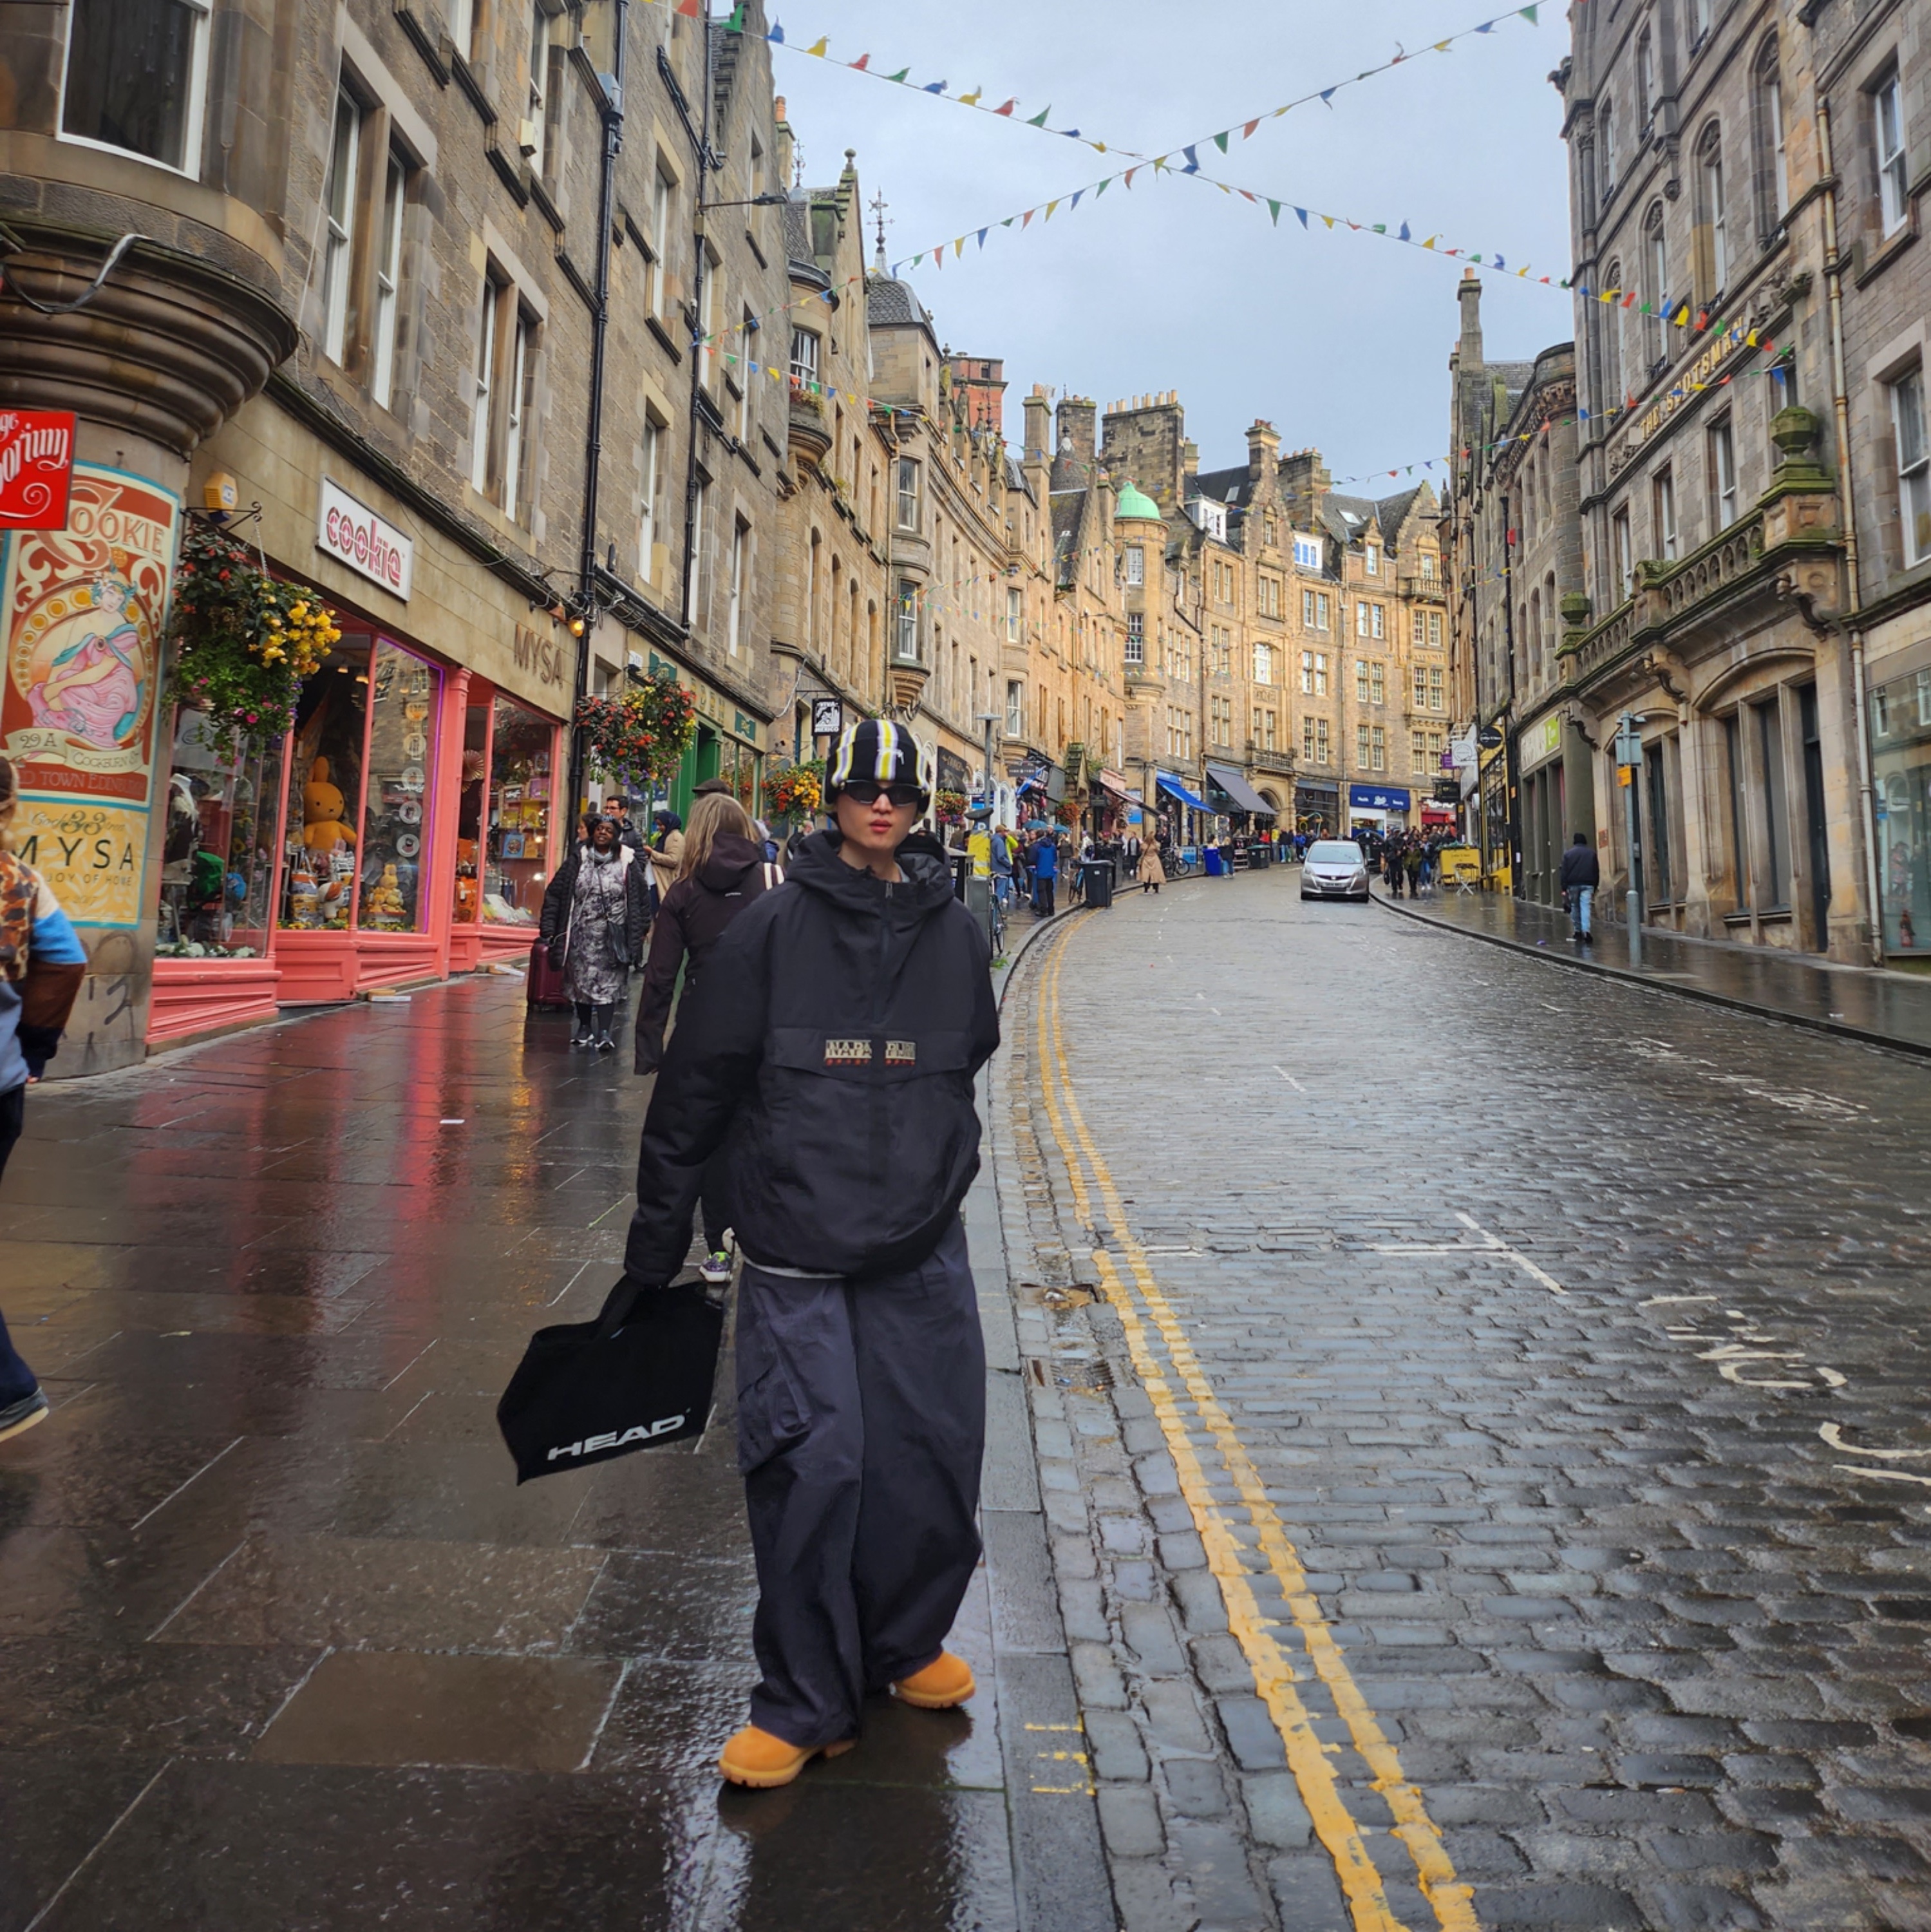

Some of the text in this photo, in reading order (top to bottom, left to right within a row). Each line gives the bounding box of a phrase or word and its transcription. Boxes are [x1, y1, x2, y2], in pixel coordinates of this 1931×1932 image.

[1640, 316, 1744, 439] THE SCOTSMAN
[514, 623, 563, 691] MYSA
[40, 771, 85, 788] TOWN
[83, 874, 100, 884] OF
[106, 875, 132, 886] HOME
[547, 1414, 686, 1461] HEAD
